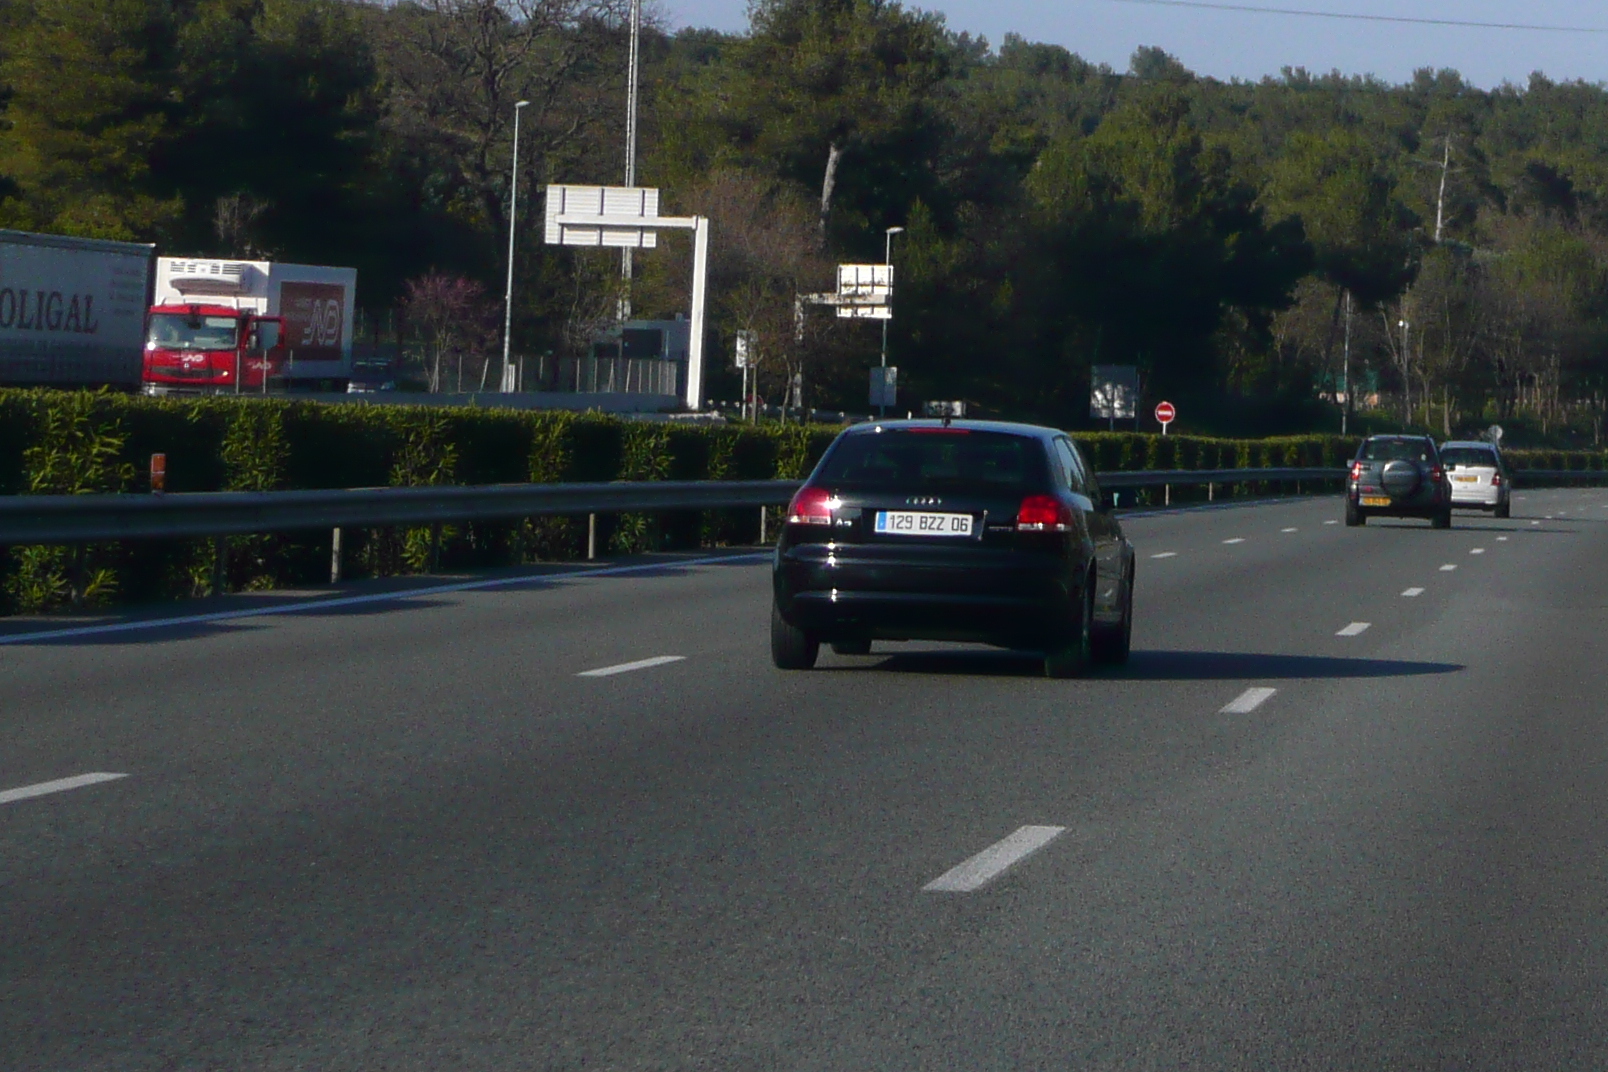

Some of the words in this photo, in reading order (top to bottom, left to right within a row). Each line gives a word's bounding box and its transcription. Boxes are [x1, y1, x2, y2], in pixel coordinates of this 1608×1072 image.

[889, 514, 913, 530] 129
[919, 515, 945, 531] BZZ
[951, 517, 969, 532] 06
